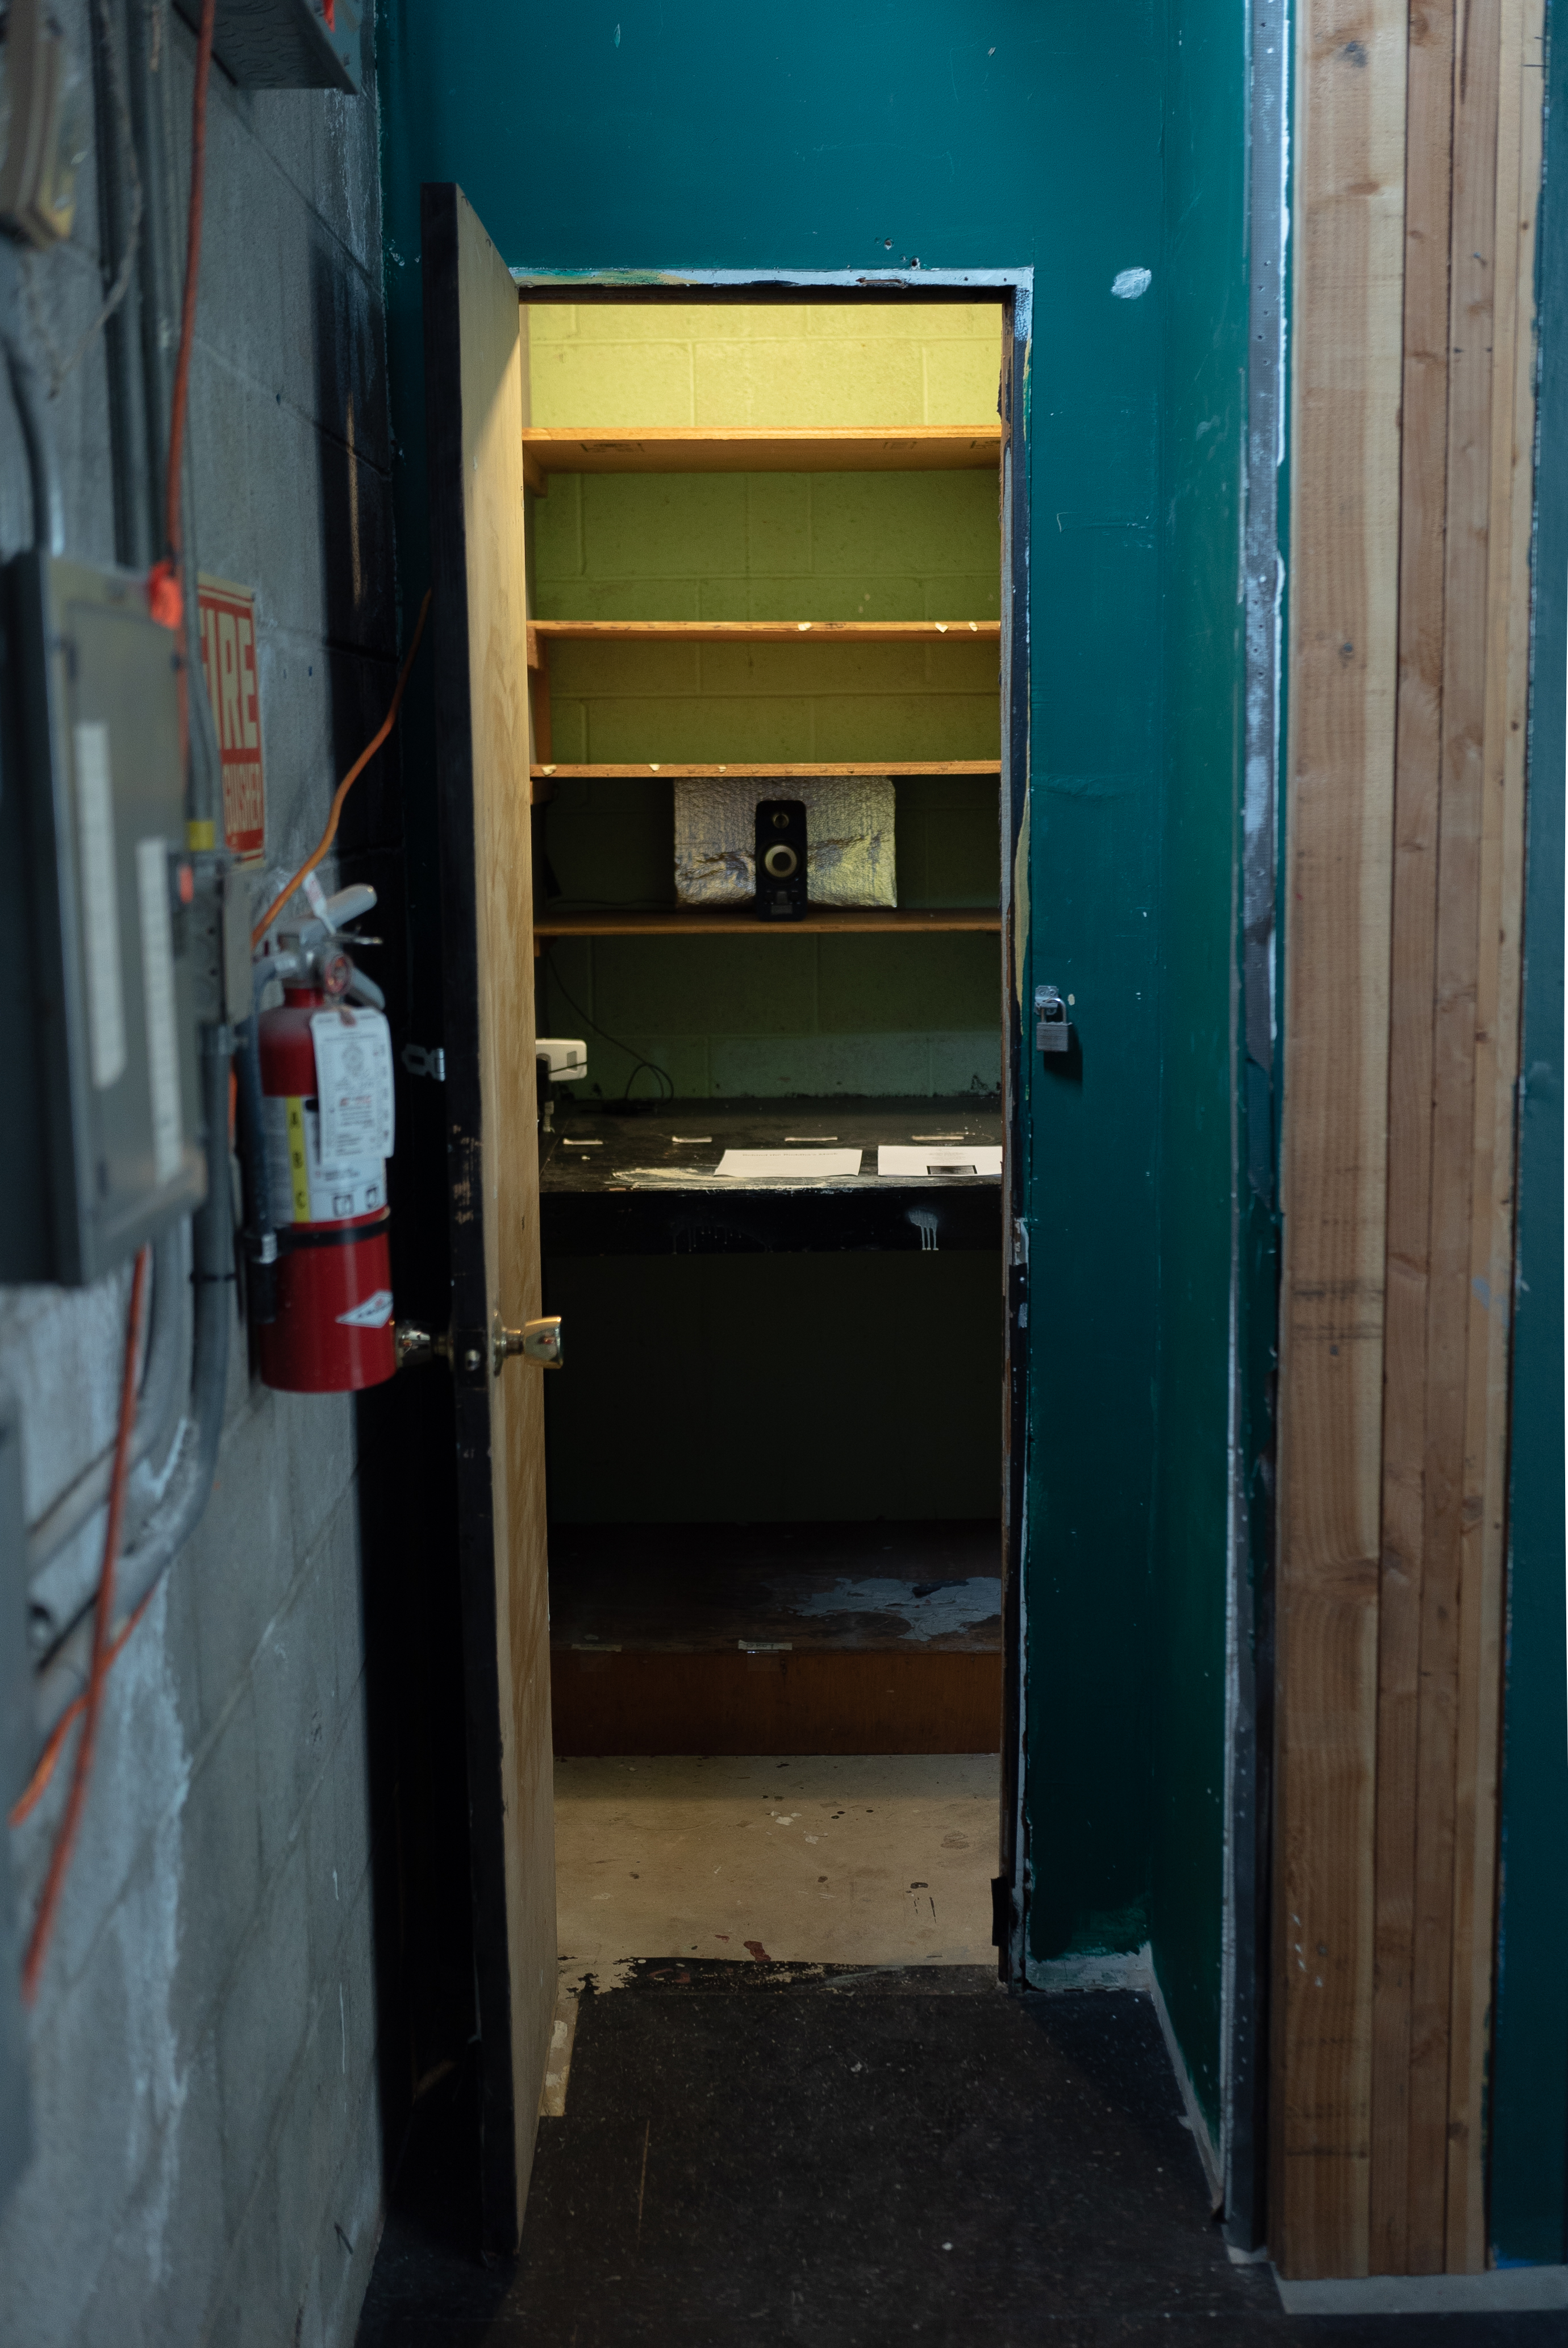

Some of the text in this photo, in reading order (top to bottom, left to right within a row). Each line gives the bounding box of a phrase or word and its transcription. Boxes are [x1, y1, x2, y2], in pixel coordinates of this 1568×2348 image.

[289, 1110, 301, 1129] A
[291, 1150, 303, 1169] B
[295, 1189, 306, 1209] C
